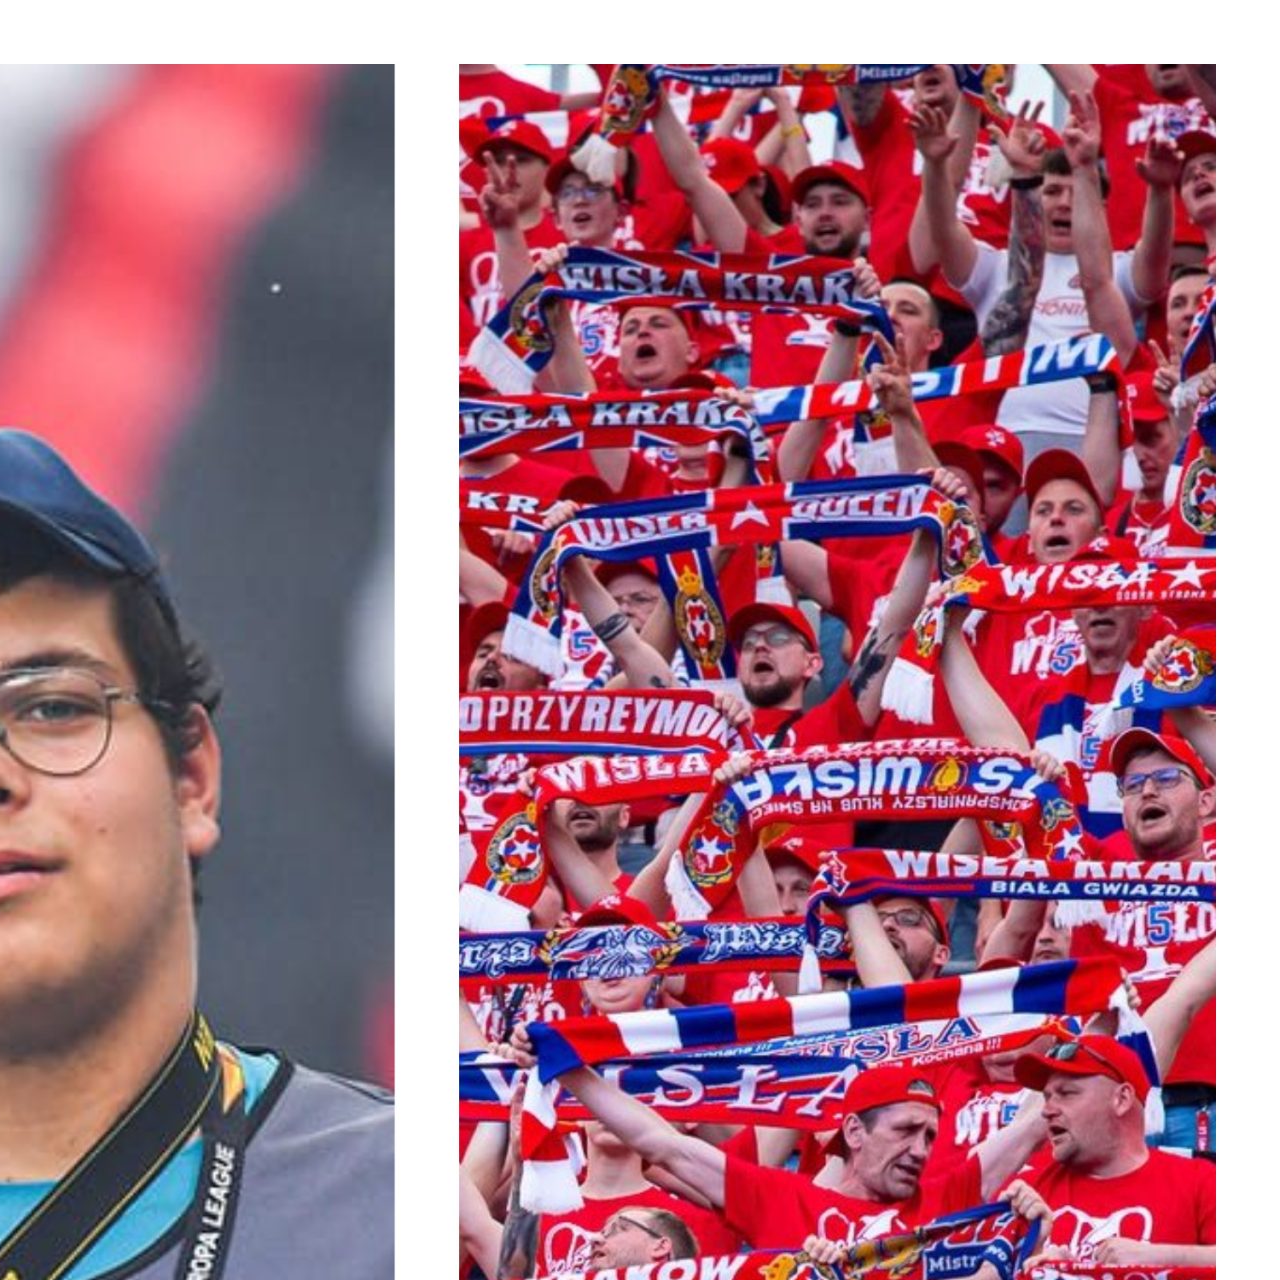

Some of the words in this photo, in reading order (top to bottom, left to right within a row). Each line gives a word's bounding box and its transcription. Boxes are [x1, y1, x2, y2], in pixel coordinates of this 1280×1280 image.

[560, 265, 706, 299] WISŁA
[537, 752, 711, 794] WISŁA
[990, 880, 1071, 895] BIAŁA
[1083, 882, 1200, 898] GWIAZDA
[202, 1143, 237, 1228] LEAGUE
